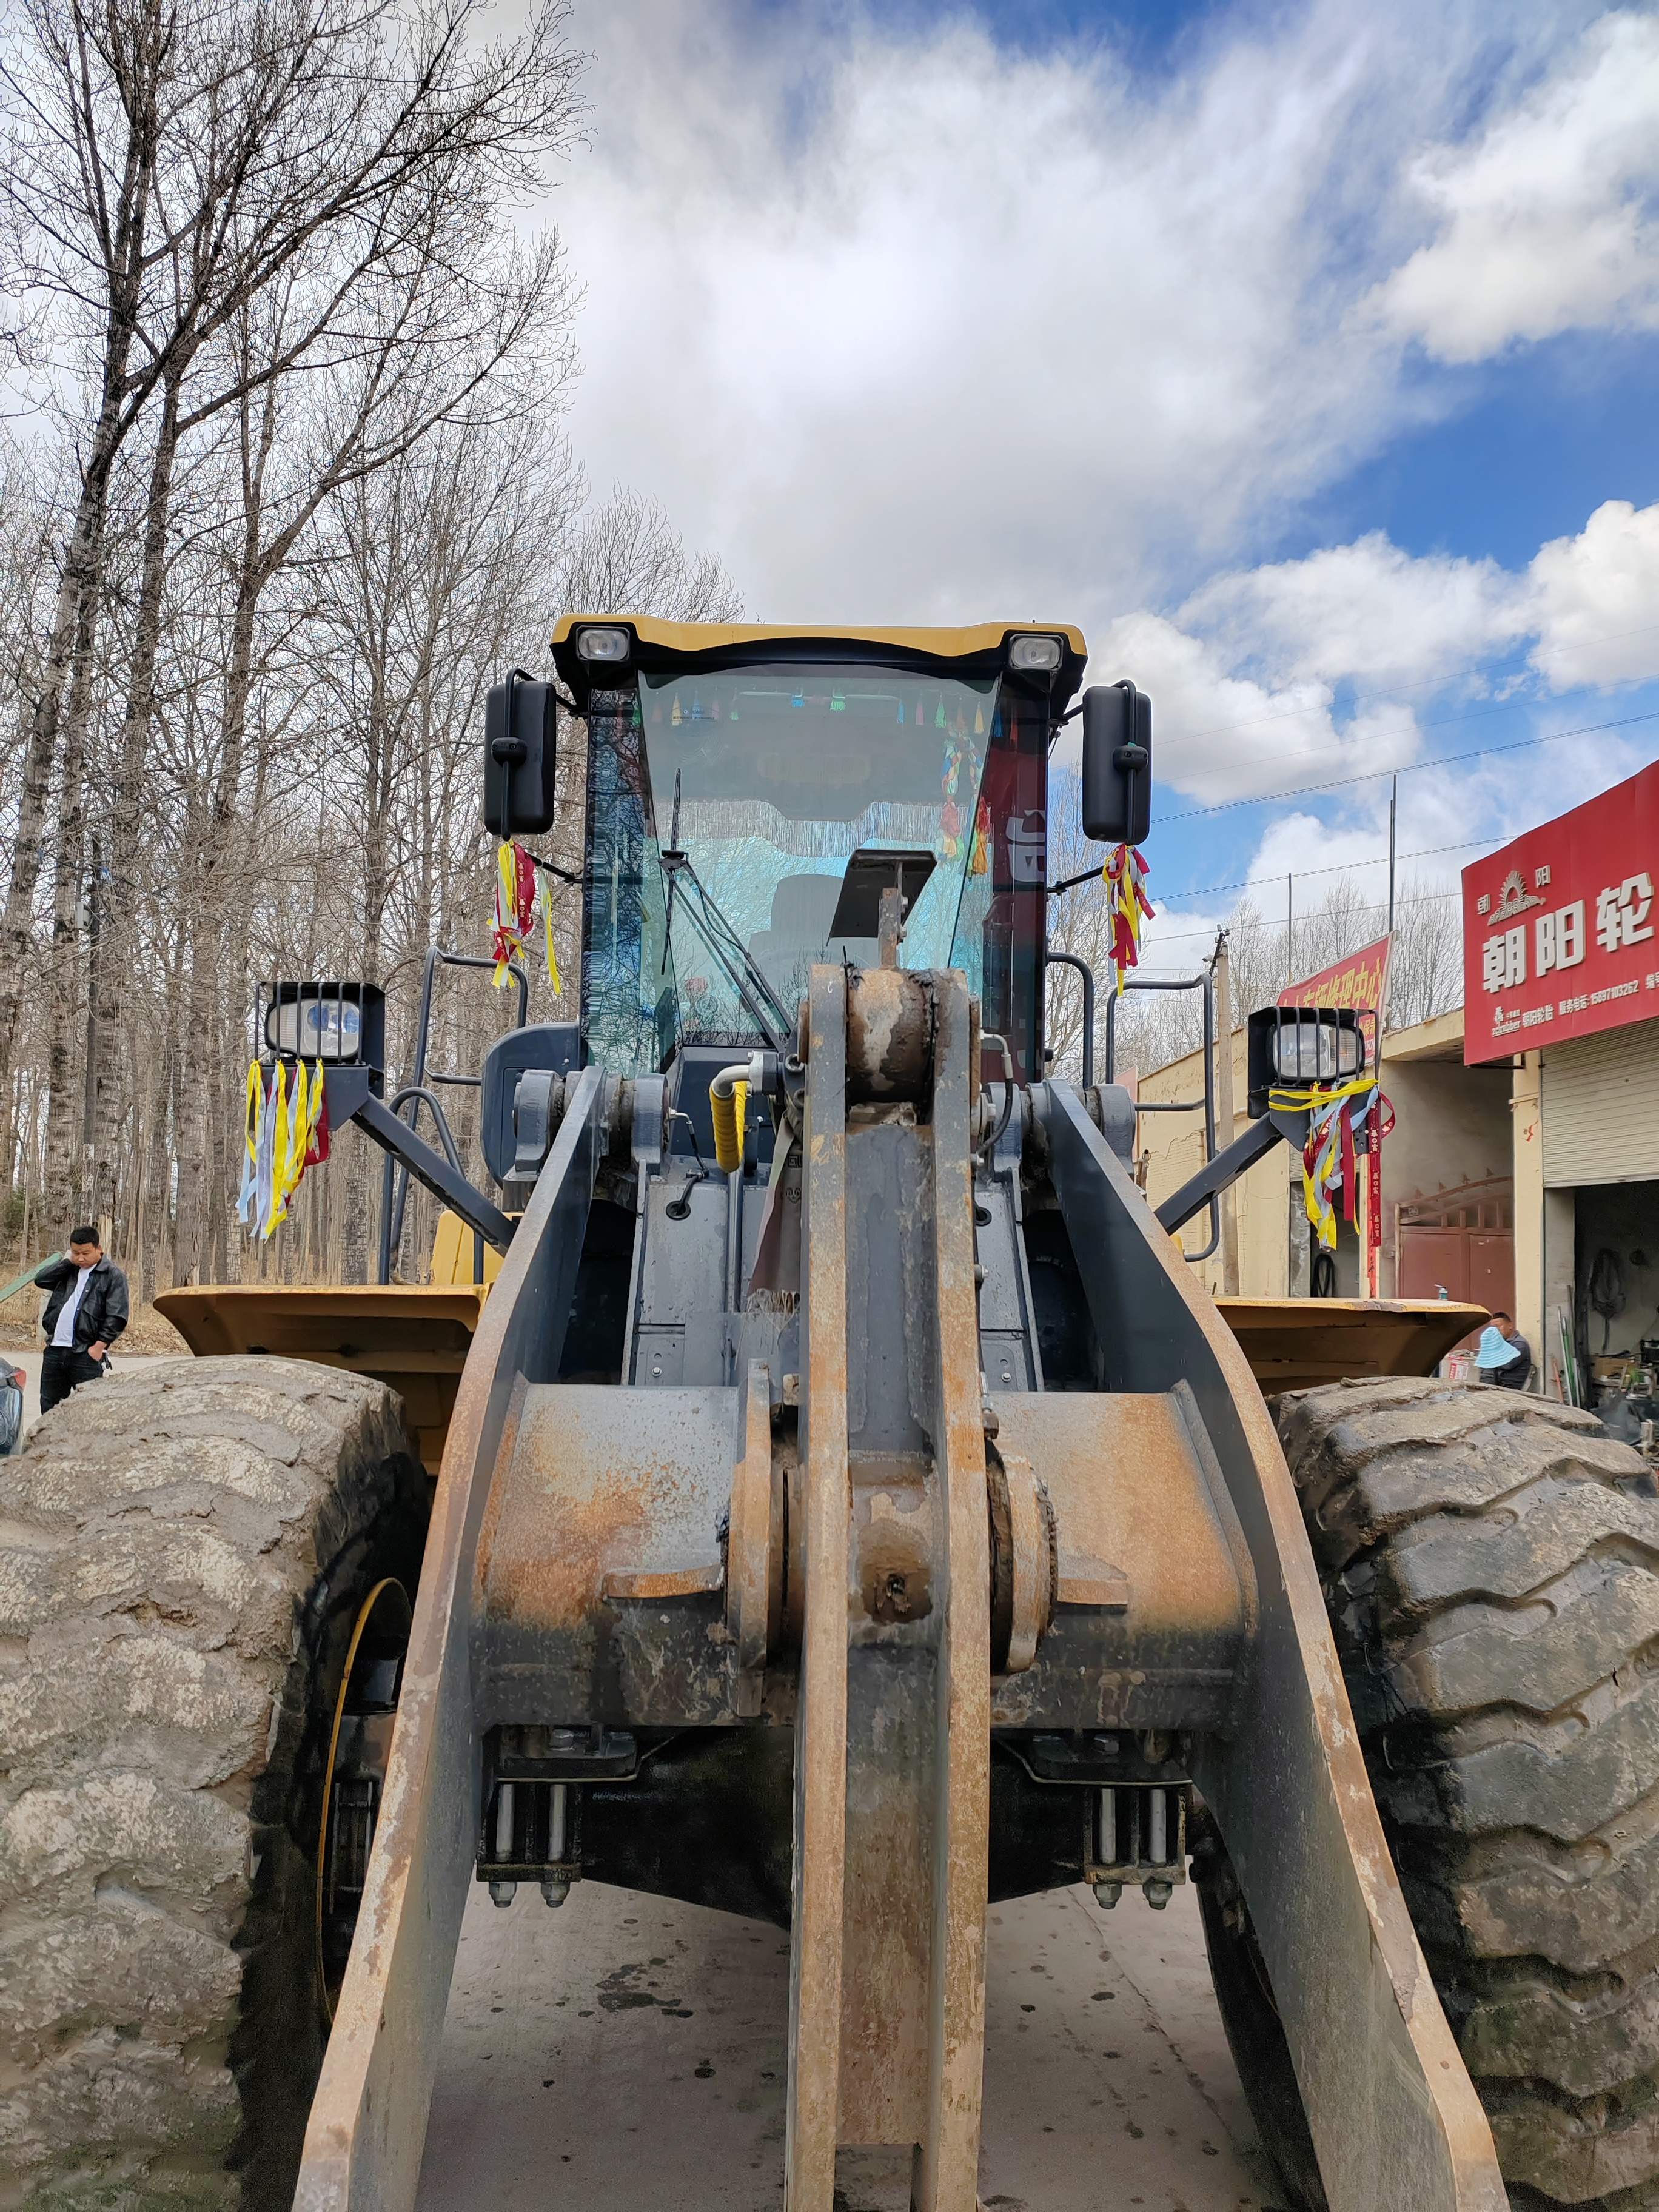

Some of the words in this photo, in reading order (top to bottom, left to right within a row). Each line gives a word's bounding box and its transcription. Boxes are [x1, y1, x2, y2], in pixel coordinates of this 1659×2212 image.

[1477, 894, 1490, 915] 朝
[1535, 865, 1551, 888] 阳
[1483, 872, 1655, 993] 朝阳轮
